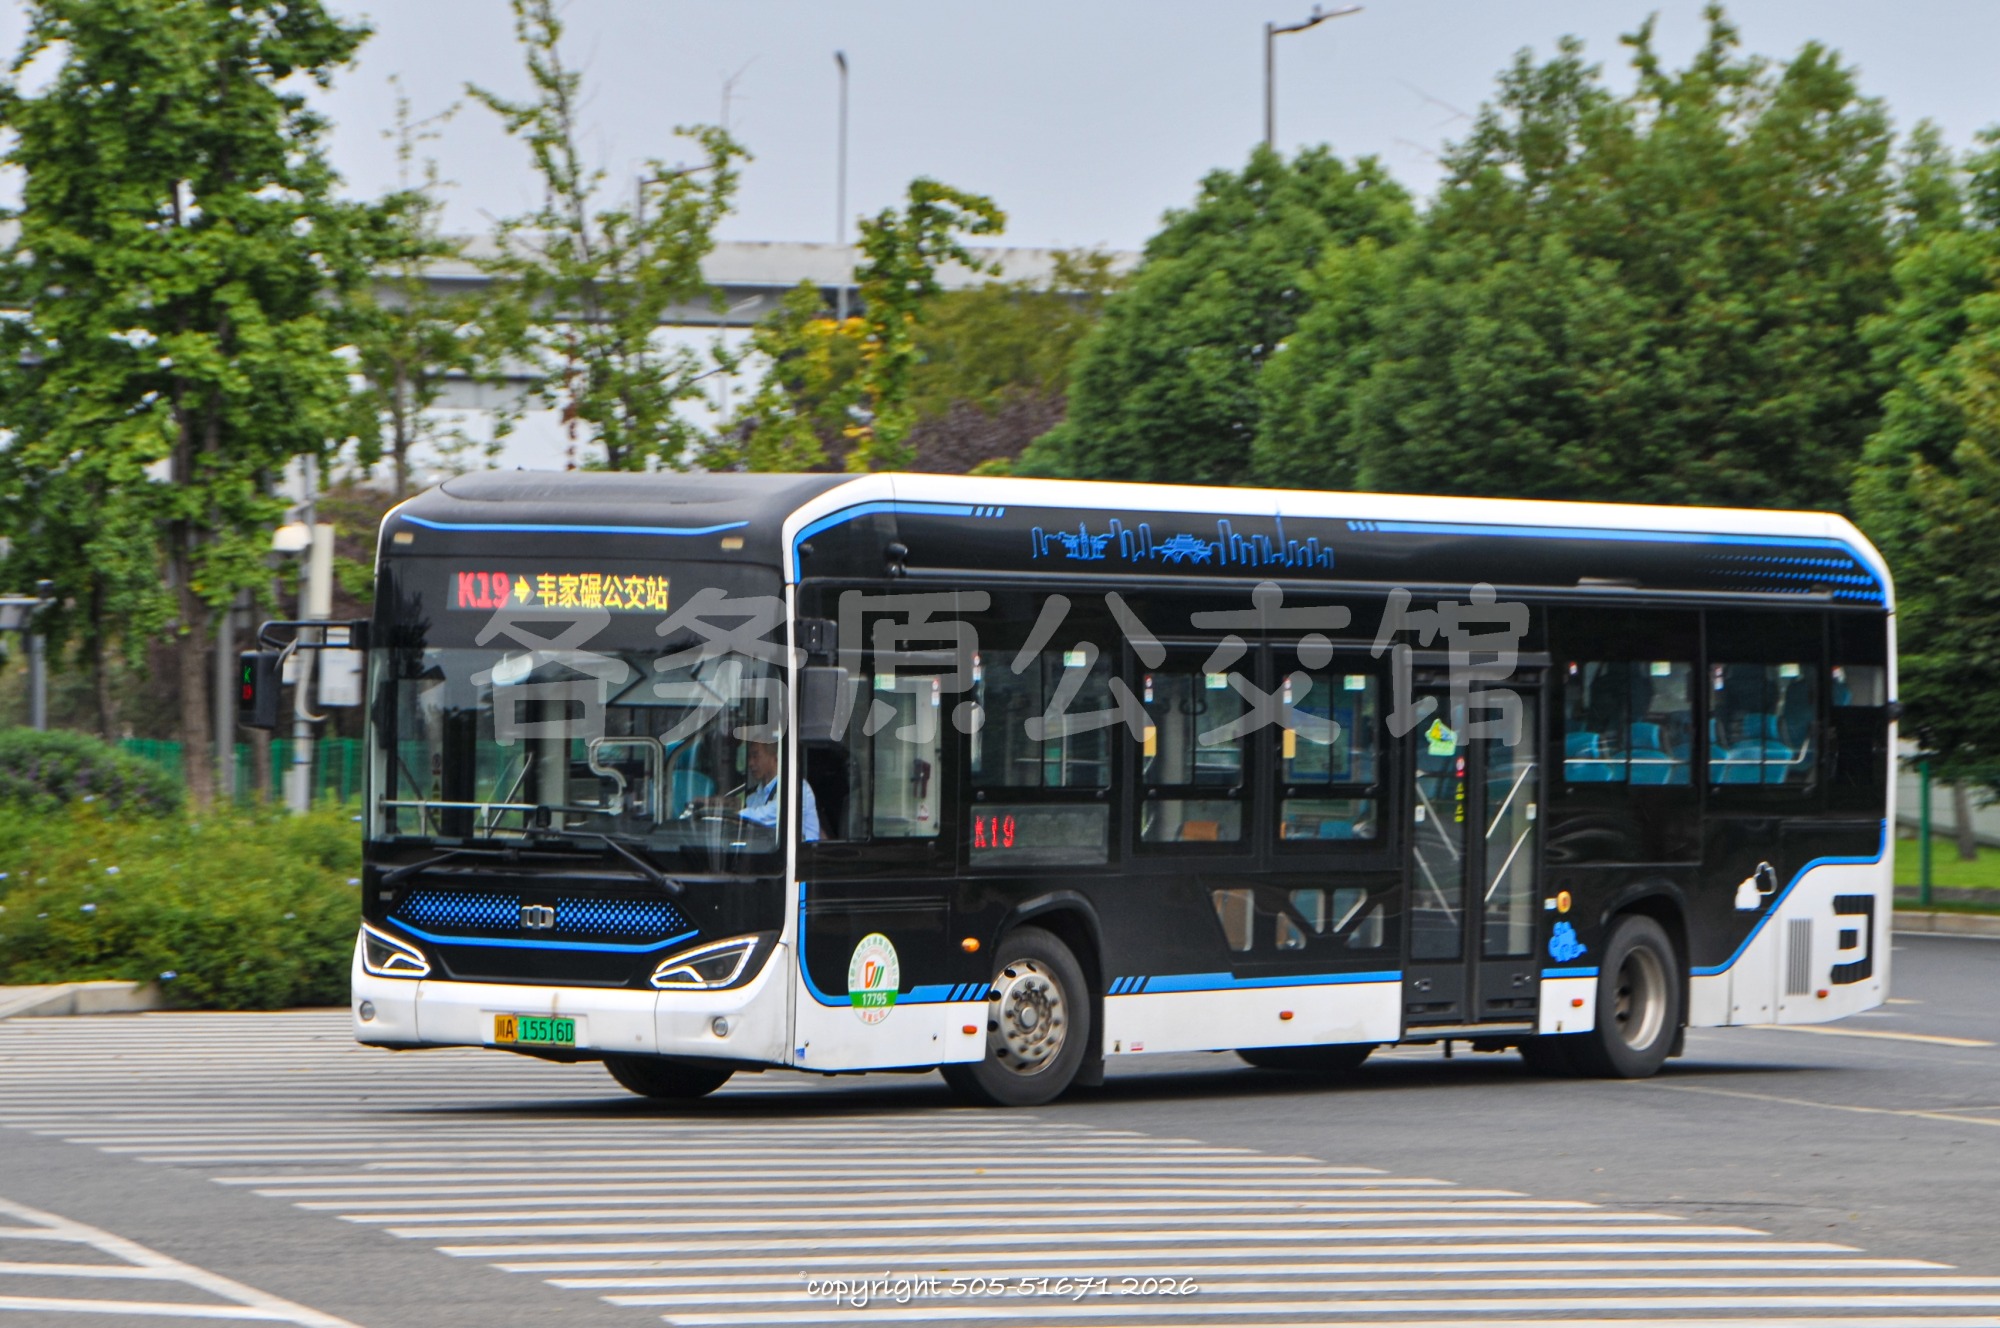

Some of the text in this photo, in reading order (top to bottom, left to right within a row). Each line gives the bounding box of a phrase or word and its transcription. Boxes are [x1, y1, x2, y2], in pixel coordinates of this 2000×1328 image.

[458, 572, 669, 611] K19 韦家碾公交站
[974, 814, 1015, 848] K19
[862, 993, 887, 1006] 17795
